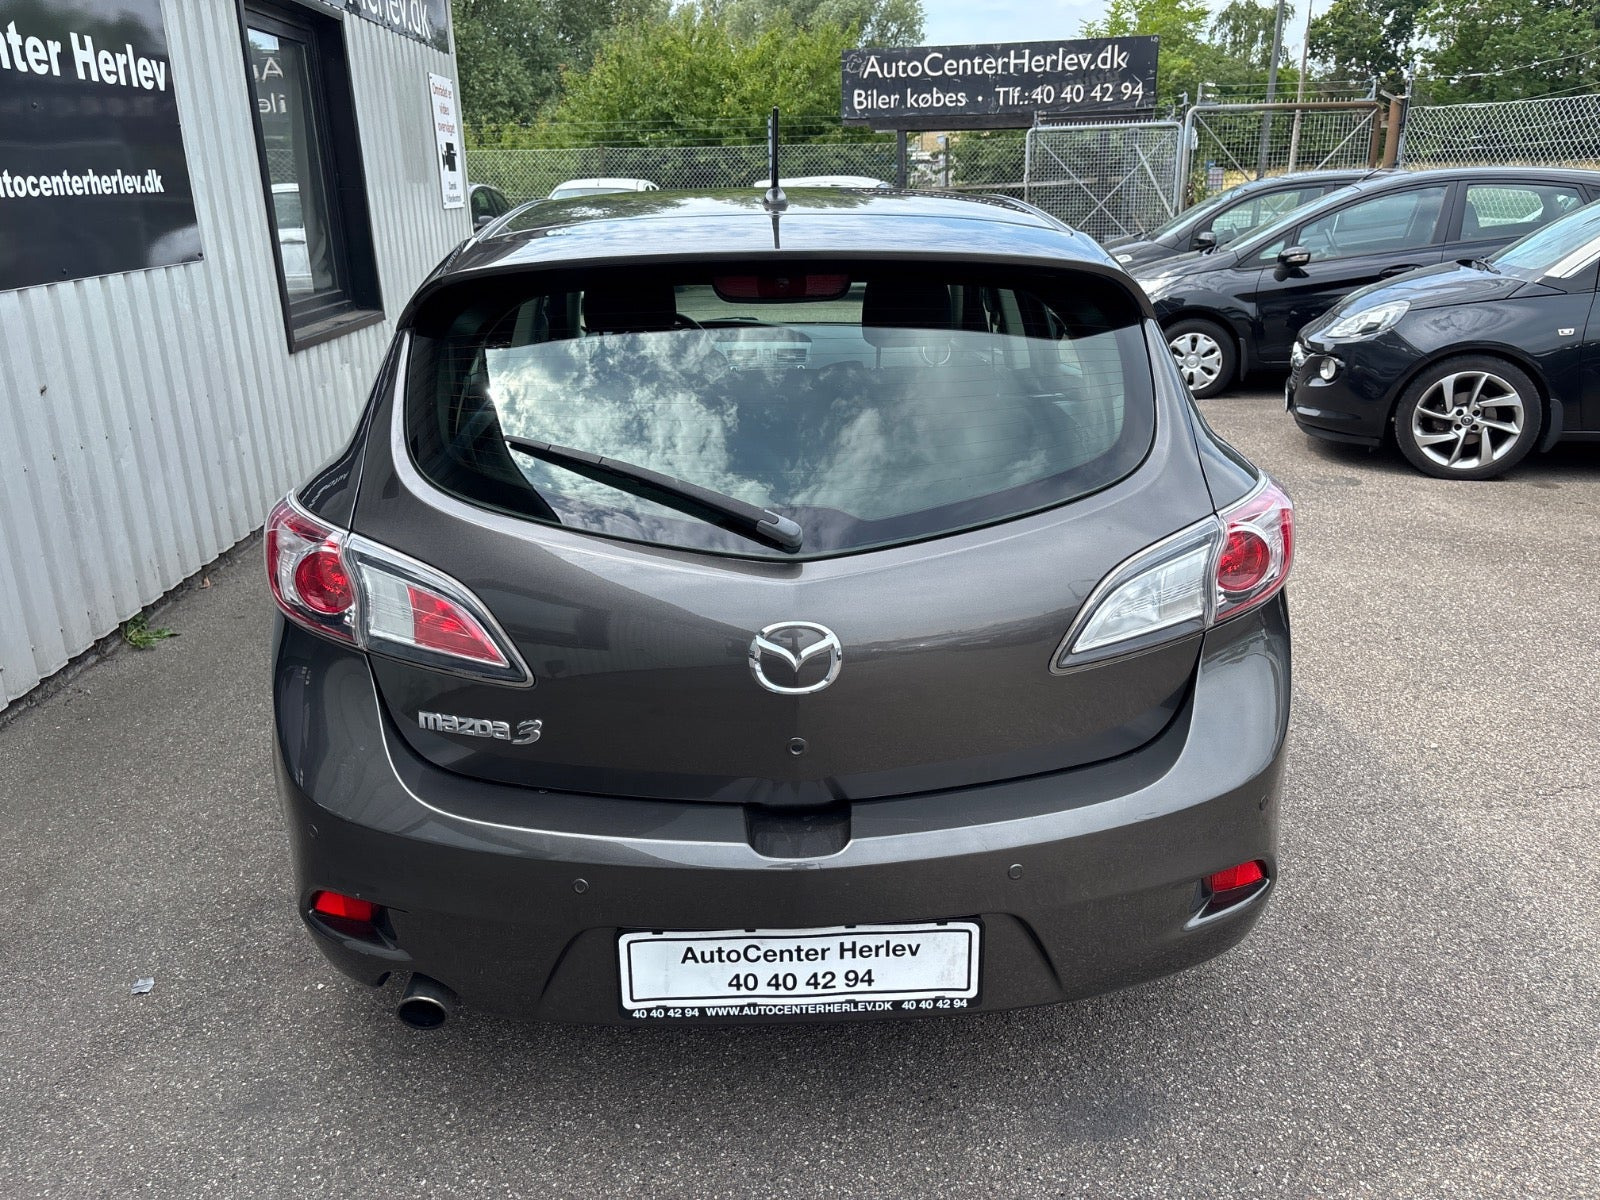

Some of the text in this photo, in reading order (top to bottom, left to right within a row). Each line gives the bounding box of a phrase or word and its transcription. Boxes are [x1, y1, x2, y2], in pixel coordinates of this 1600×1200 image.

[70, 32, 165, 91] Herlev
[863, 44, 1128, 79] AutoCenterHerlev.dk
[853, 88, 900, 110] Biler
[906, 86, 967, 108] købes
[1060, 83, 1084, 103] 40
[1090, 82, 1113, 102] 42
[1120, 82, 1145, 102] 94
[680, 939, 921, 964] AutoCenter Herlev
[728, 968, 875, 991] 40 40 42 94
[632, 998, 968, 1019] 40 40 42 94 WWW.AUTOCENTERHERLEV.DK 40 40 42 94
